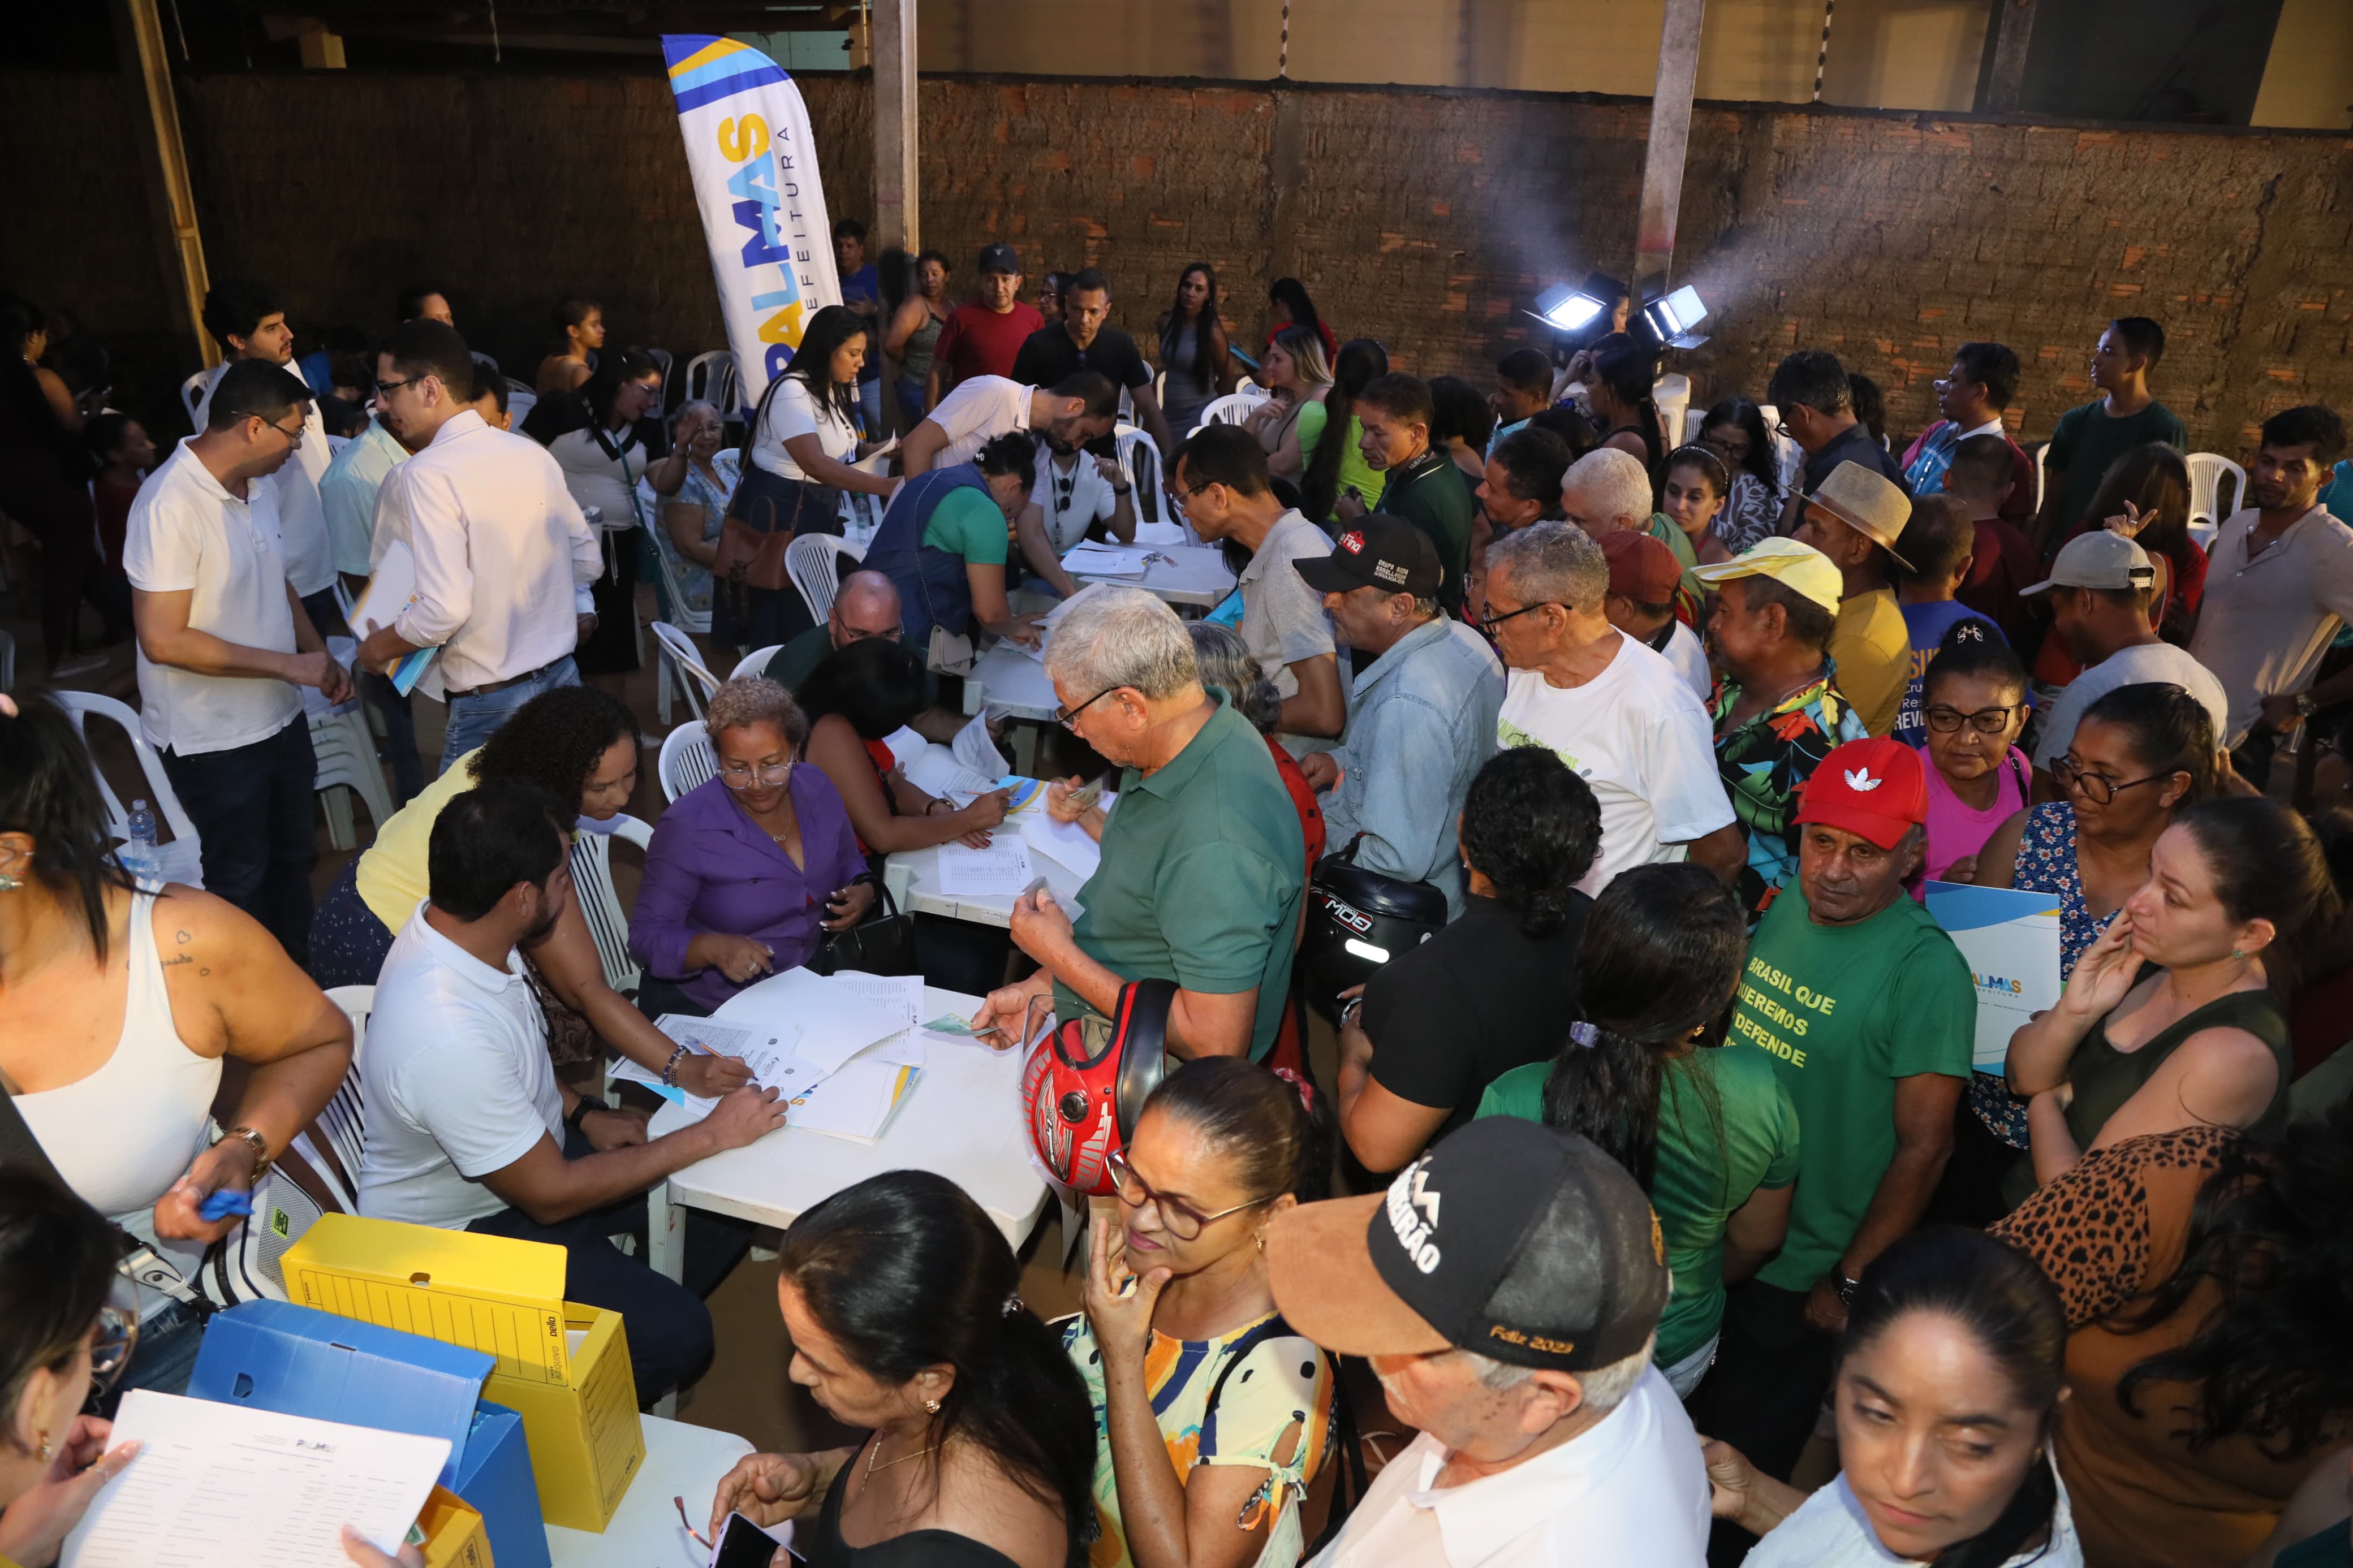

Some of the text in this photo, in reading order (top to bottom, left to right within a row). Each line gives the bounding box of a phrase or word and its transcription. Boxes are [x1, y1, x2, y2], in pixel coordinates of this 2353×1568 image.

[1343, 533, 1361, 552] Fina
[1736, 980, 1808, 1036] UEREMOS
[1748, 957, 1837, 1015] BRASIL QUE
[1972, 973, 2022, 994] ALMAS
[1734, 1012, 1807, 1068] DEPENDE
